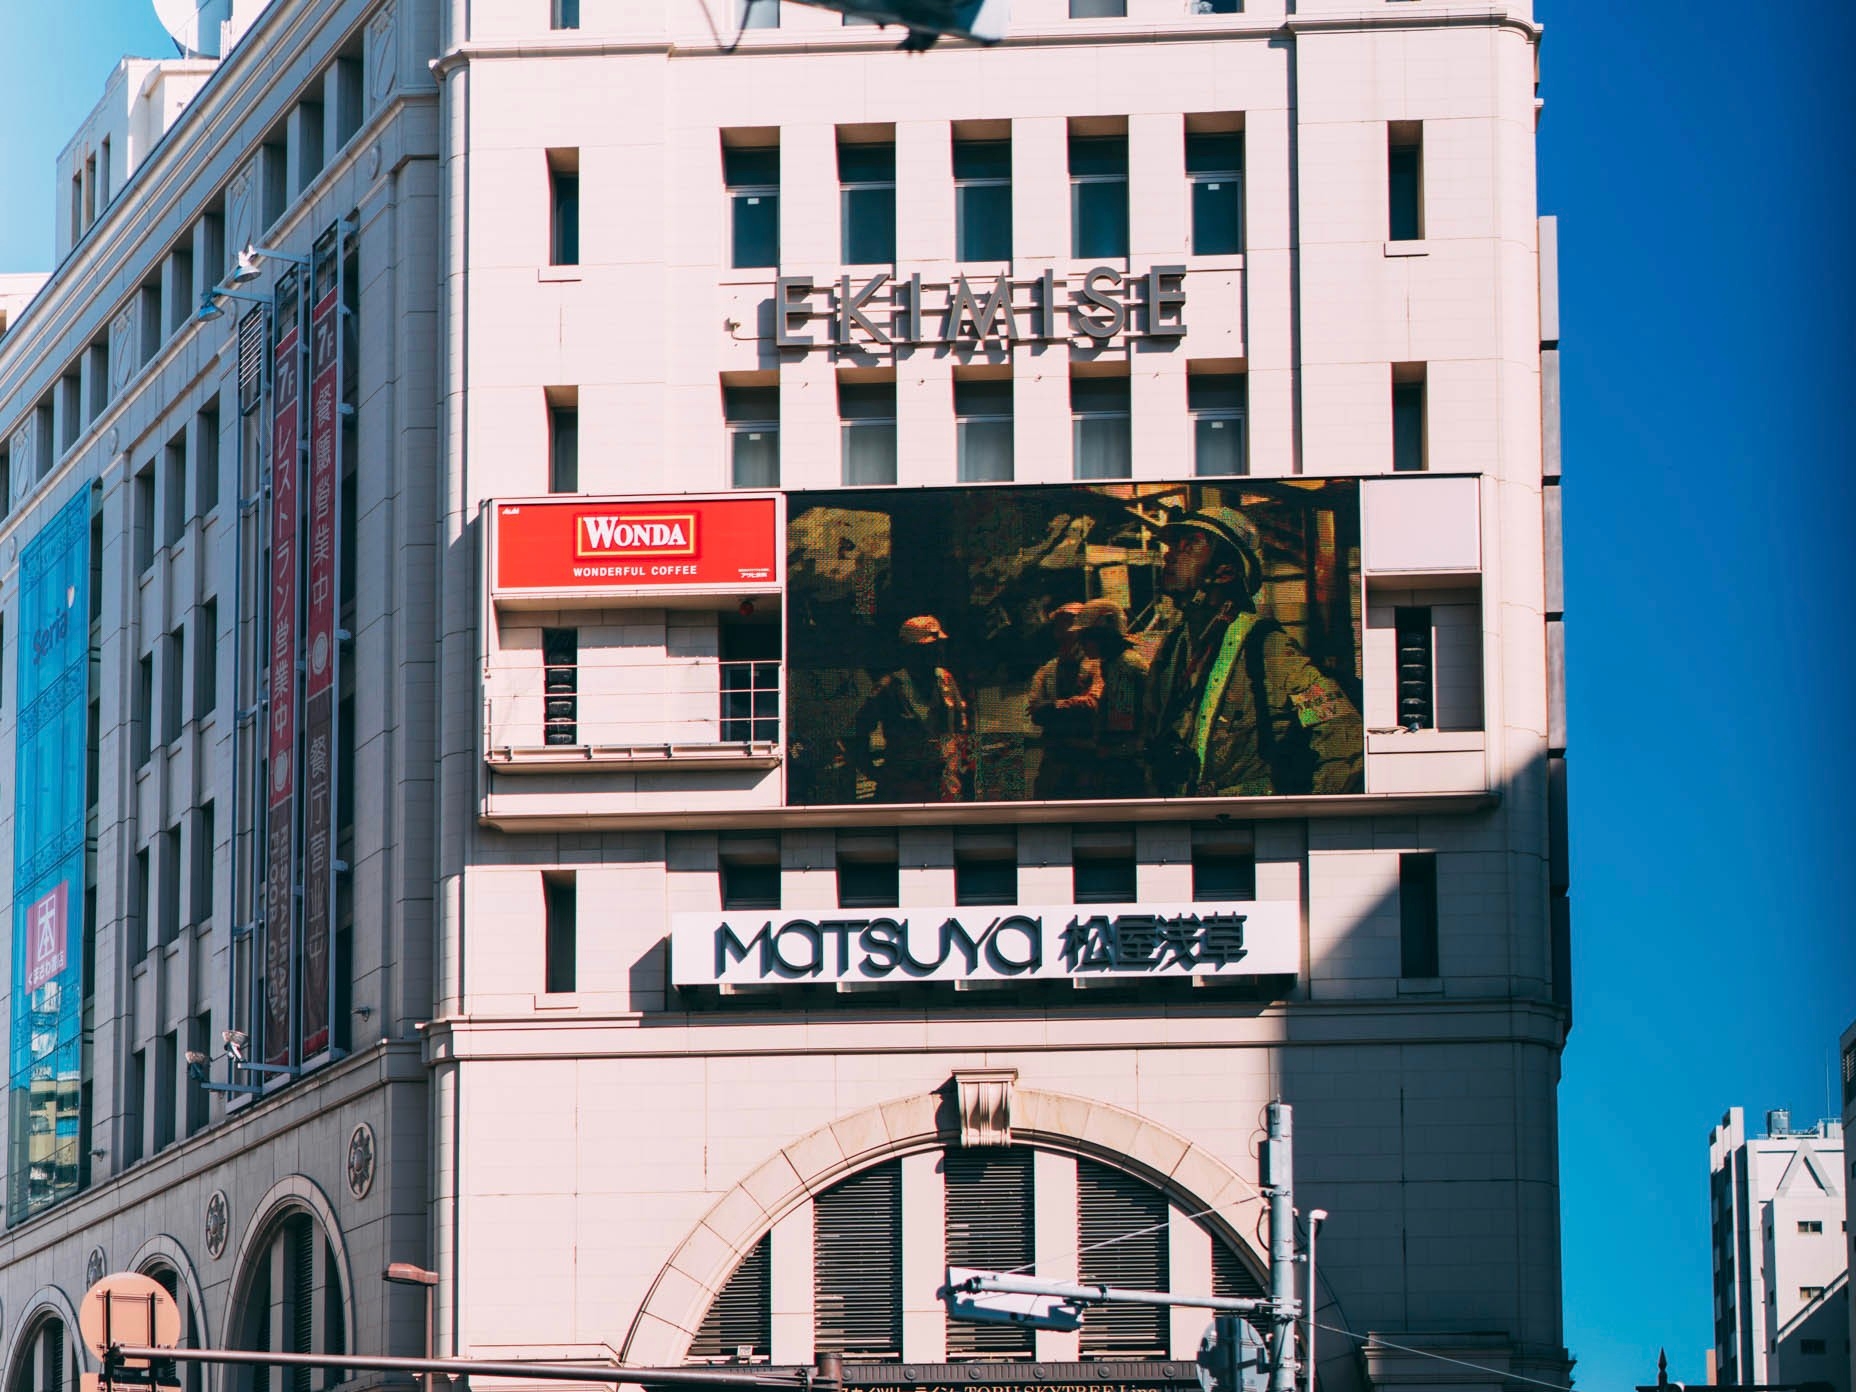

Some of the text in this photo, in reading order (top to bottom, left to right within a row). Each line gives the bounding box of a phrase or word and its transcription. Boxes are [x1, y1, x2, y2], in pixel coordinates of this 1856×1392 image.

[776, 264, 1187, 347] EKIMISE
[317, 321, 333, 366] 7F
[278, 360, 295, 405] 7F
[583, 516, 687, 548] WONDA
[573, 565, 697, 577] WONDERFUL COFFEE
[1064, 911, 1249, 971] 松屋浅草
